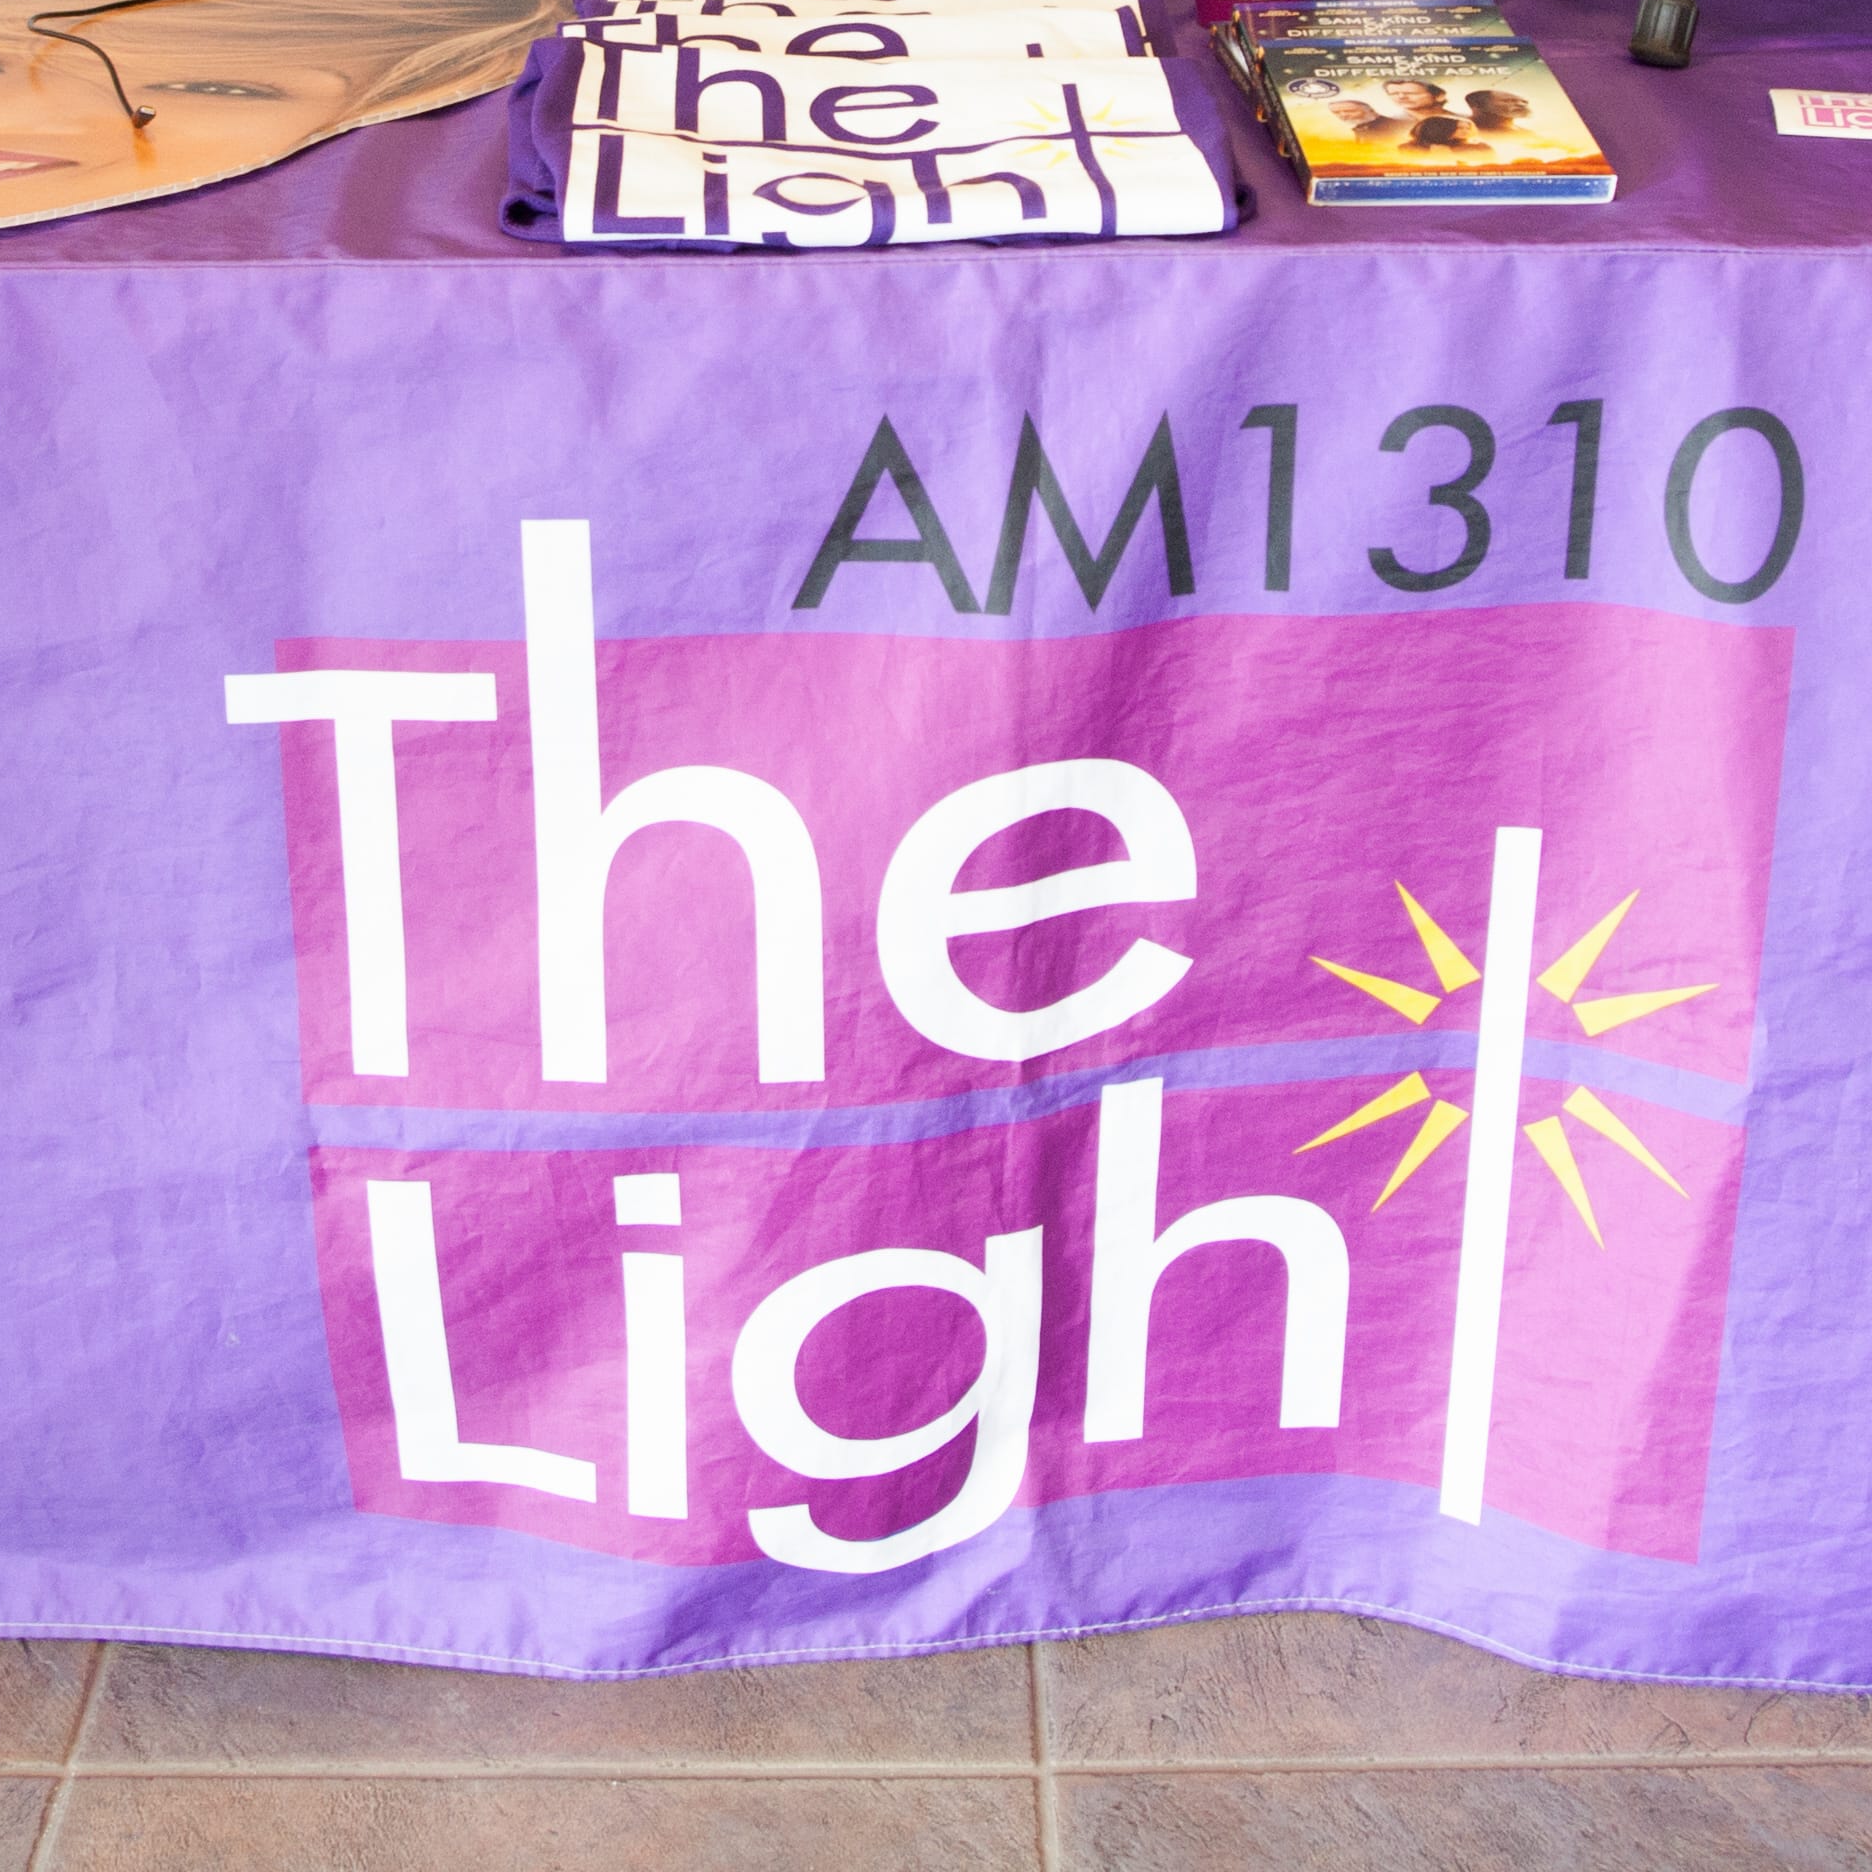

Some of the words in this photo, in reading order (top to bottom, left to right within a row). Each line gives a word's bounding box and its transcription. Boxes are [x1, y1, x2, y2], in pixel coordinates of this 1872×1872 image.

[582, 39, 939, 144] The
[592, 83, 1116, 248] Light
[1314, 68, 1436, 77] DIFFERENT
[790, 398, 1804, 618] AM1310
[224, 518, 1200, 1085] The
[367, 827, 1541, 1575] Light
